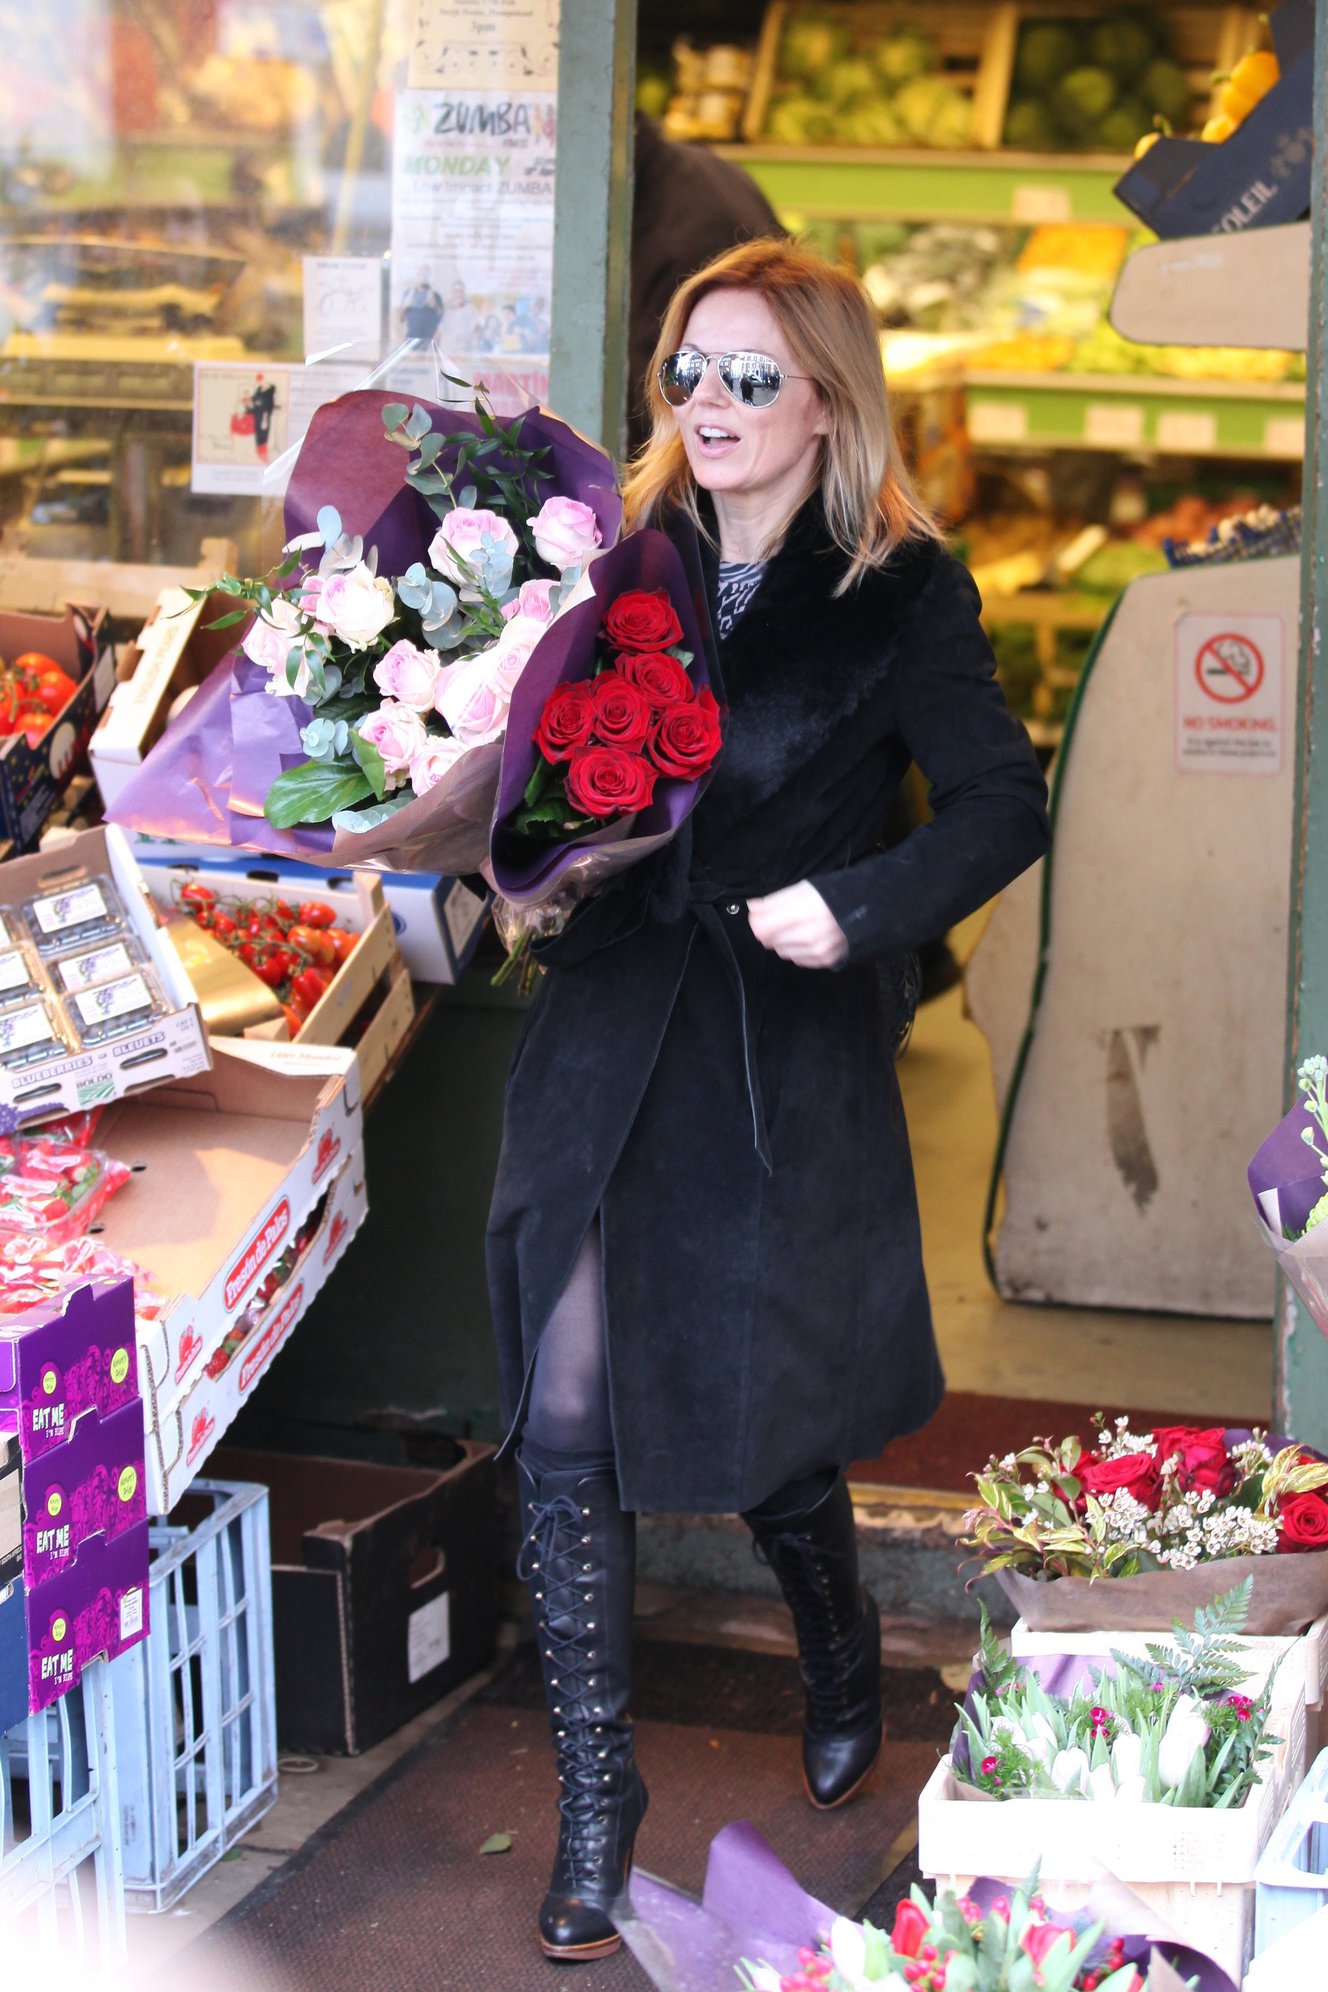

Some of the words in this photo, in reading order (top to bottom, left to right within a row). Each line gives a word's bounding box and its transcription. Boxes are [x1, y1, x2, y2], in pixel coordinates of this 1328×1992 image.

[432, 101, 531, 137] ZUMBA
[403, 155, 511, 176] MONDAY
[497, 180, 552, 195] ZUMBA
[1183, 716, 1203, 730] NO
[1209, 718, 1276, 732] SMOKING
[12, 1056, 93, 1088] BLUEBERRIES
[112, 1031, 166, 1057] BLEUETS
[76, 1073, 113, 1089] BOLDO
[255, 1240, 268, 1264] de
[33, 1407, 50, 1431] EAT
[51, 1403, 65, 1428] ME
[37, 1529, 55, 1554] EAT
[56, 1524, 70, 1549] ME
[41, 1654, 59, 1680] EAT
[60, 1648, 73, 1673] ME
